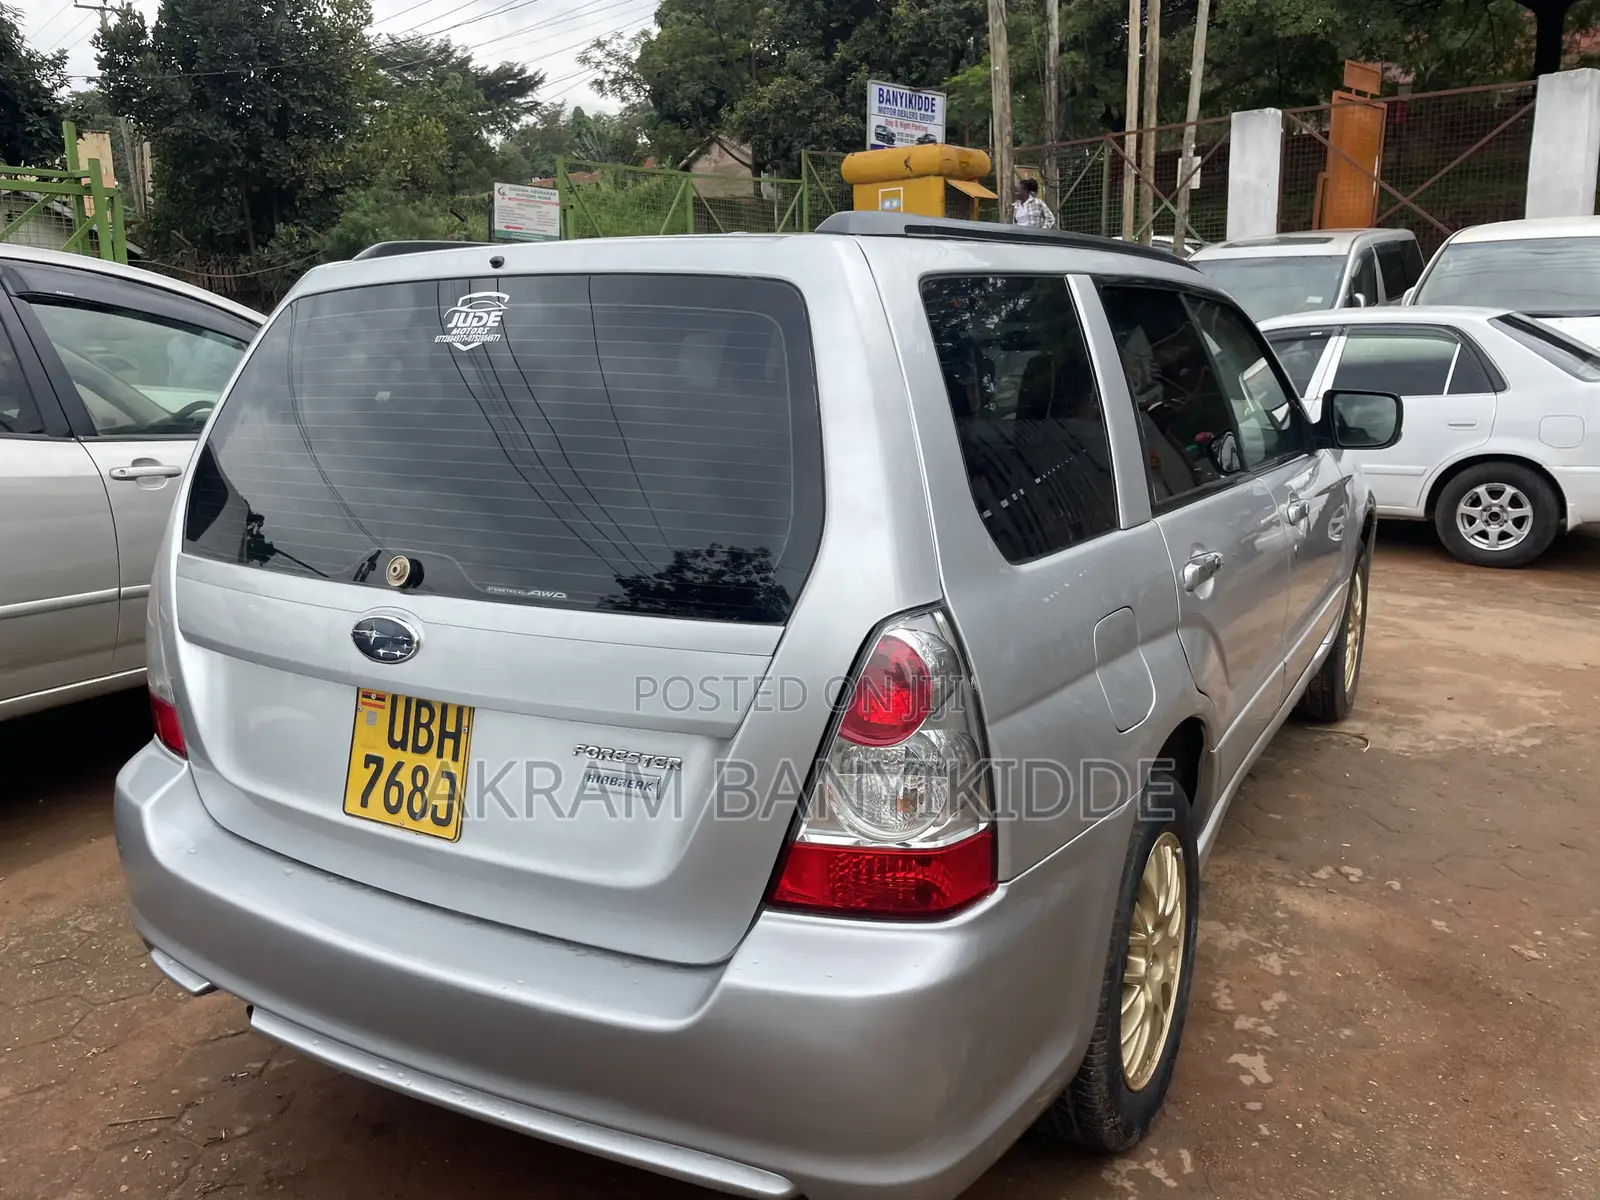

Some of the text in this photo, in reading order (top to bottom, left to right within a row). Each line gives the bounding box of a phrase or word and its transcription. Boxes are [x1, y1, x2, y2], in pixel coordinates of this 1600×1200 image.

[878, 87, 936, 114] BANYIKIDDE
[878, 105, 897, 116] MOTOR
[897, 108, 919, 121] DEALERS
[447, 311, 503, 328] JUDE
[450, 327, 490, 335] MOTORS
[527, 590, 567, 598] AWD
[387, 693, 464, 762] UBH
[572, 744, 683, 771] FORESTER
[586, 773, 654, 792] AIRBREAK
